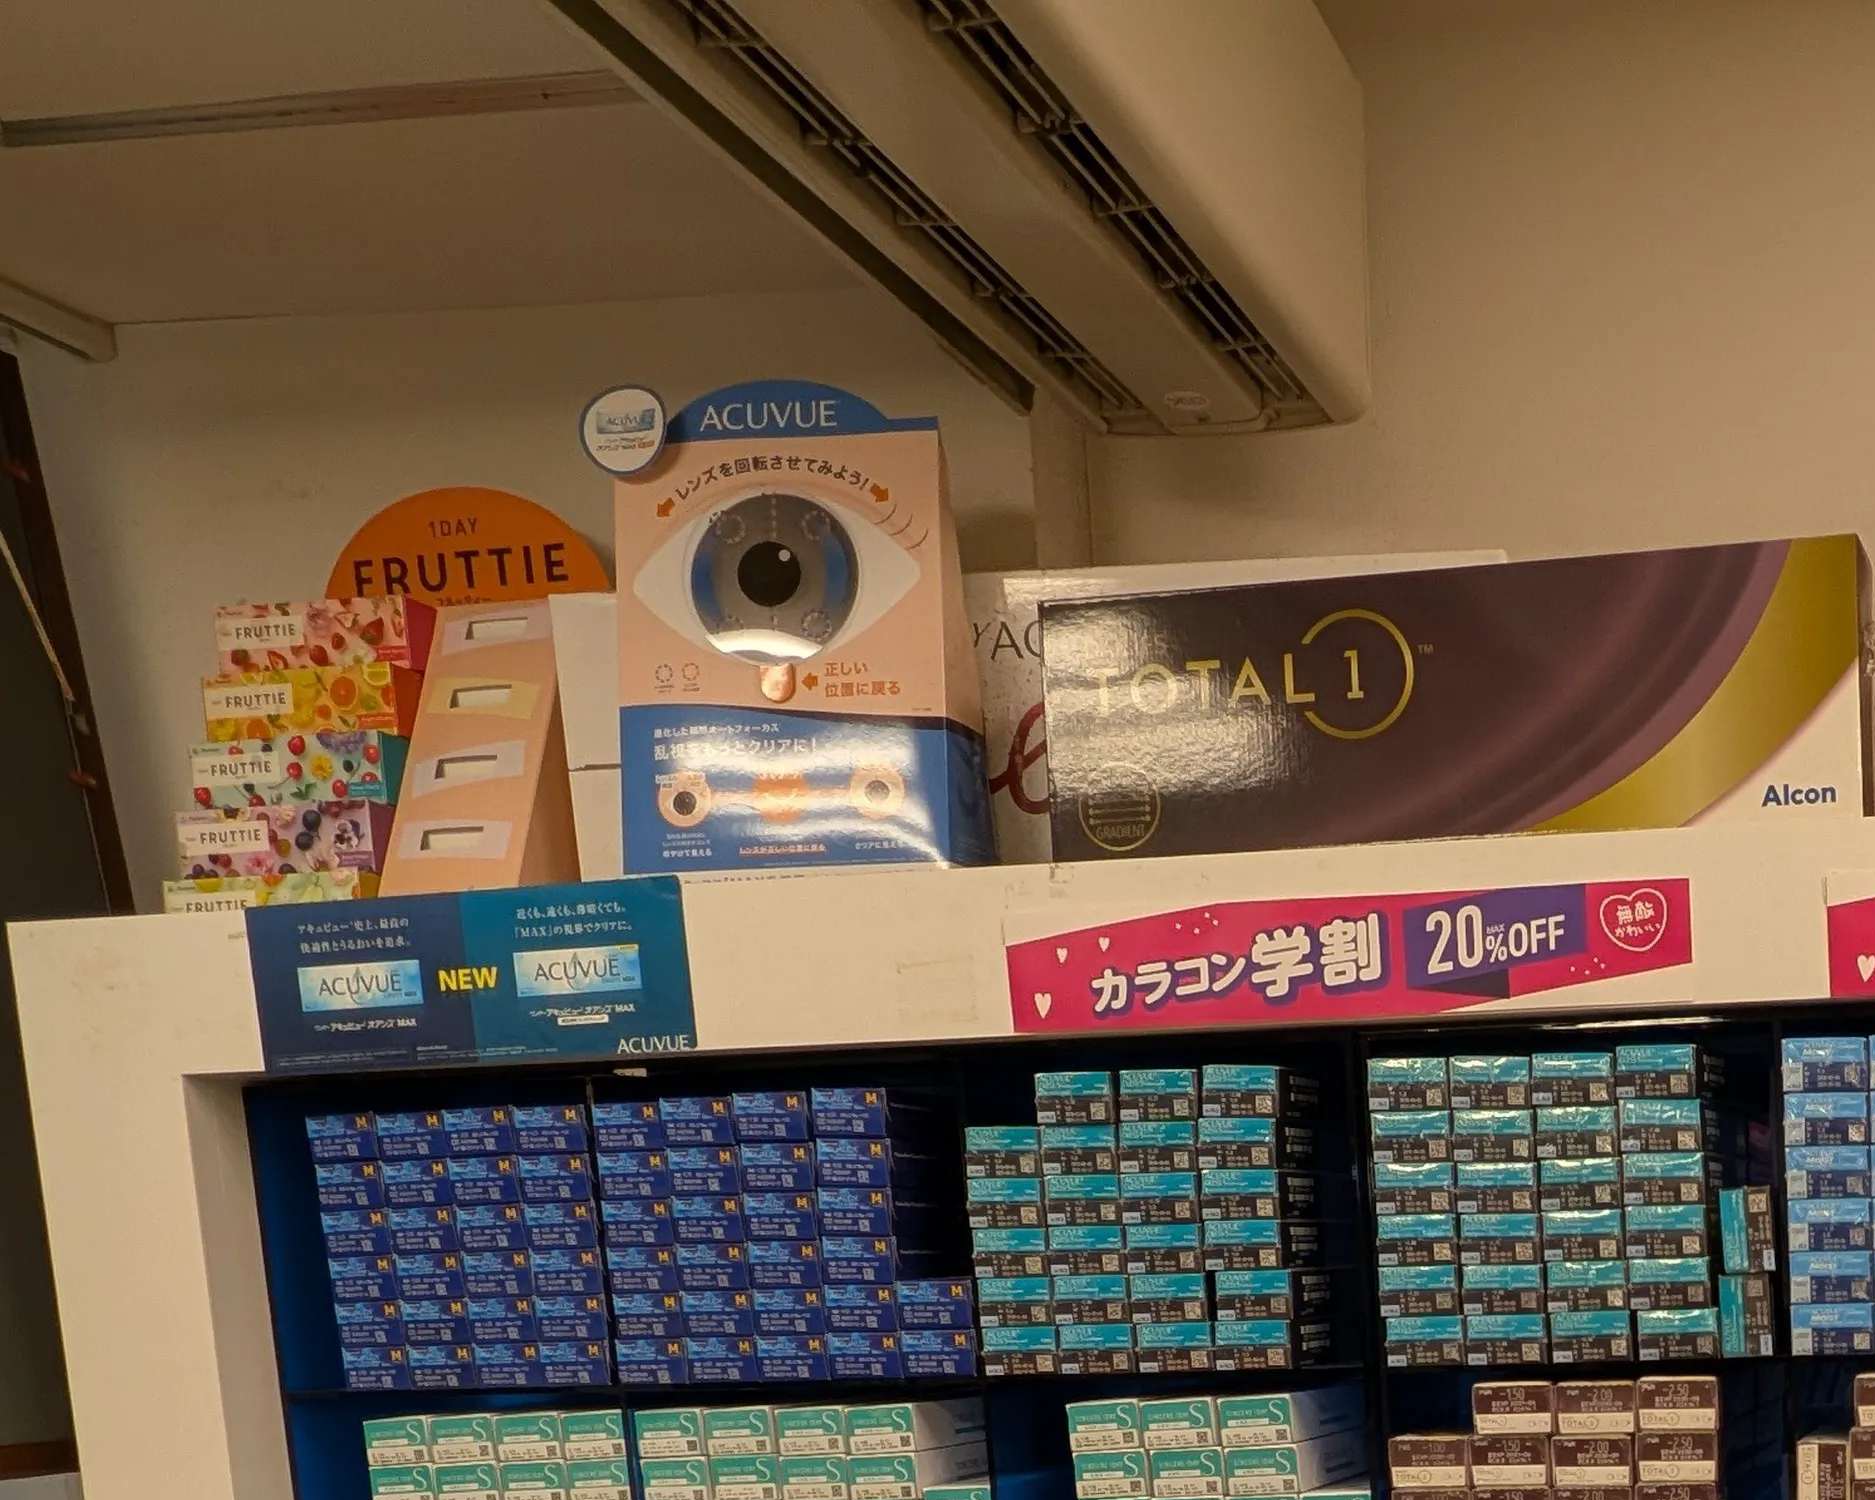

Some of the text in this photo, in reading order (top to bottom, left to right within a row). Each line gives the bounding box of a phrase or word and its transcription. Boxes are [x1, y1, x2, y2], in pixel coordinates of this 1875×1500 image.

[701, 400, 837, 432] ACUVUE
[428, 518, 478, 539] 1DAY
[353, 543, 569, 598] FRUTTIE
[235, 623, 296, 641] FRUTTIE
[824, 661, 869, 677] 正しい
[824, 680, 901, 697] 位置に戻る
[1092, 651, 1317, 716] TOTAL
[225, 692, 287, 710] FRUTTIE
[210, 759, 272, 777] FRUTTIE
[1762, 783, 1837, 808] Alcon
[200, 828, 262, 846] FRUTTIE
[534, 957, 621, 983] ACUVUE
[1090, 911, 1383, 1014] カラコン学割
[318, 971, 403, 997] ACUVUE
[437, 966, 498, 992] NEW
[617, 1034, 691, 1055] ACUVUE
